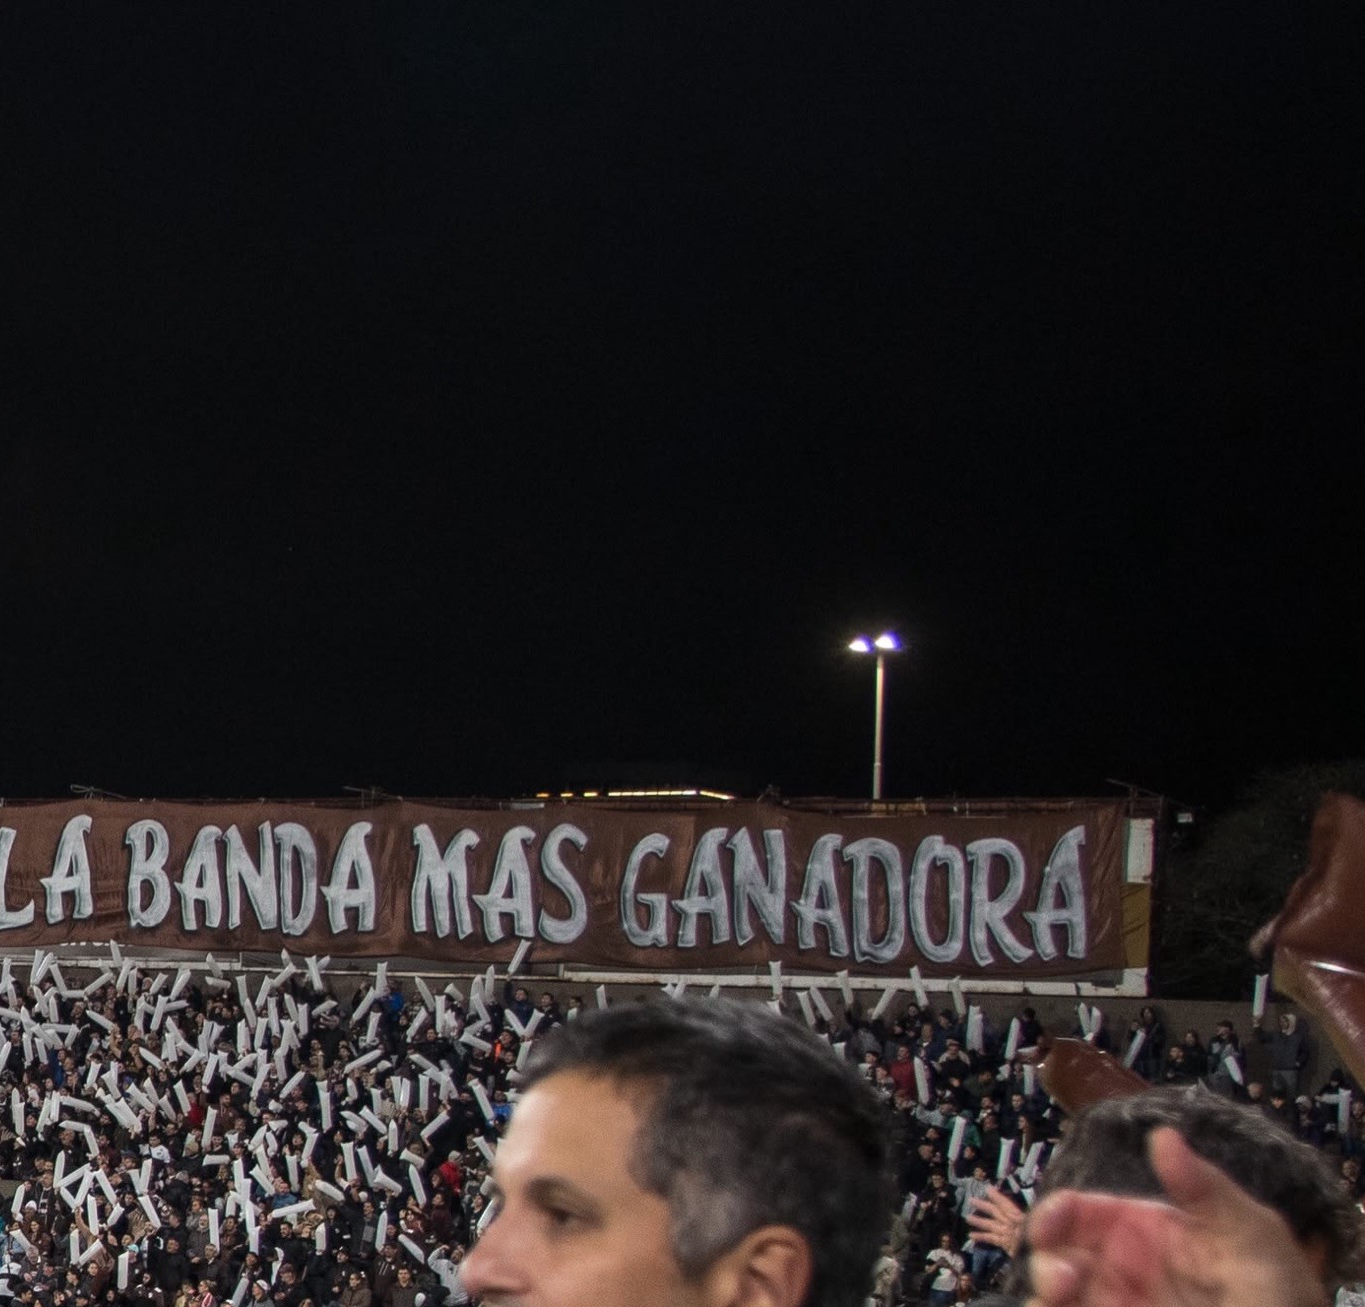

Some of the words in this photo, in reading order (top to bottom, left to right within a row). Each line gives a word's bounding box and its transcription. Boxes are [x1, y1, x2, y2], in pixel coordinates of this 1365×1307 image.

[125, 819, 375, 936] BANDA
[410, 823, 588, 944] MAS
[620, 825, 1085, 968] GANADORA
